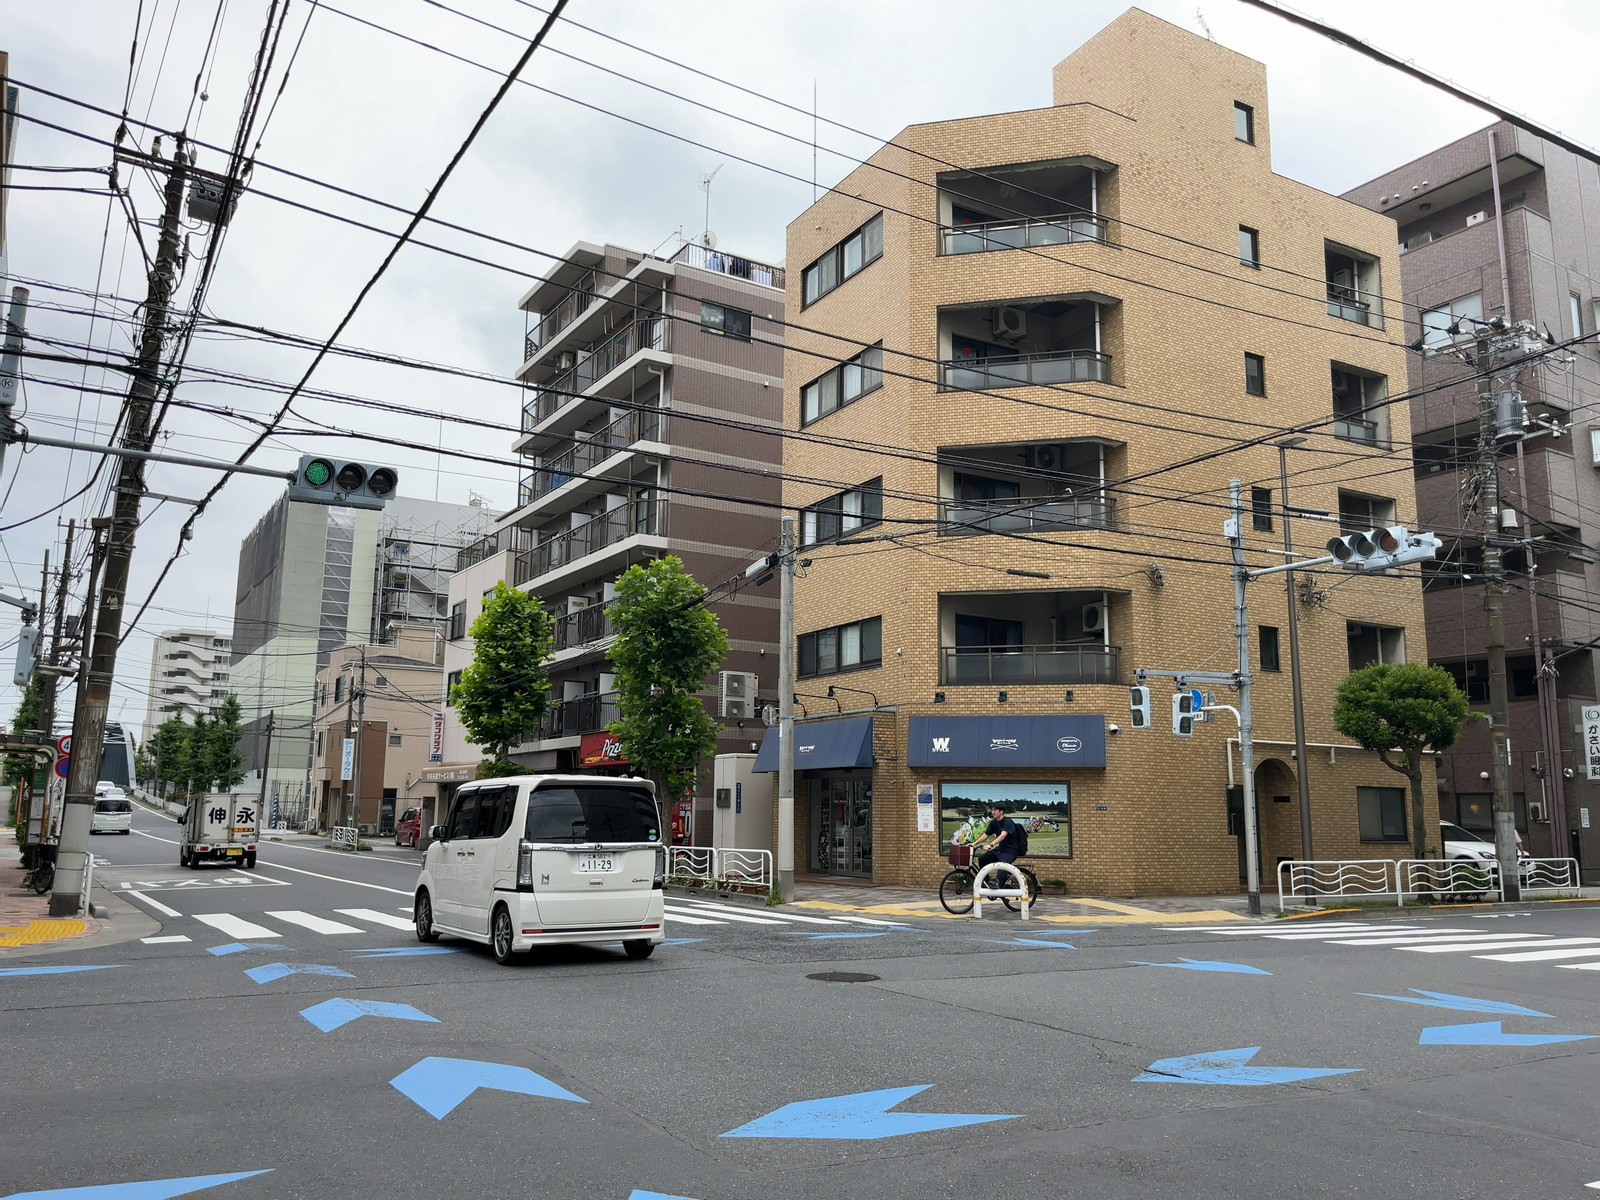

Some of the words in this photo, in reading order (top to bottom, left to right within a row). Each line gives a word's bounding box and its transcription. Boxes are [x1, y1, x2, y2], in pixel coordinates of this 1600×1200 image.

[433, 721, 443, 753] タコグラフ
[932, 737, 950, 749] W
[208, 806, 256, 825] 伸永
[588, 860, 612, 870] 11-29
